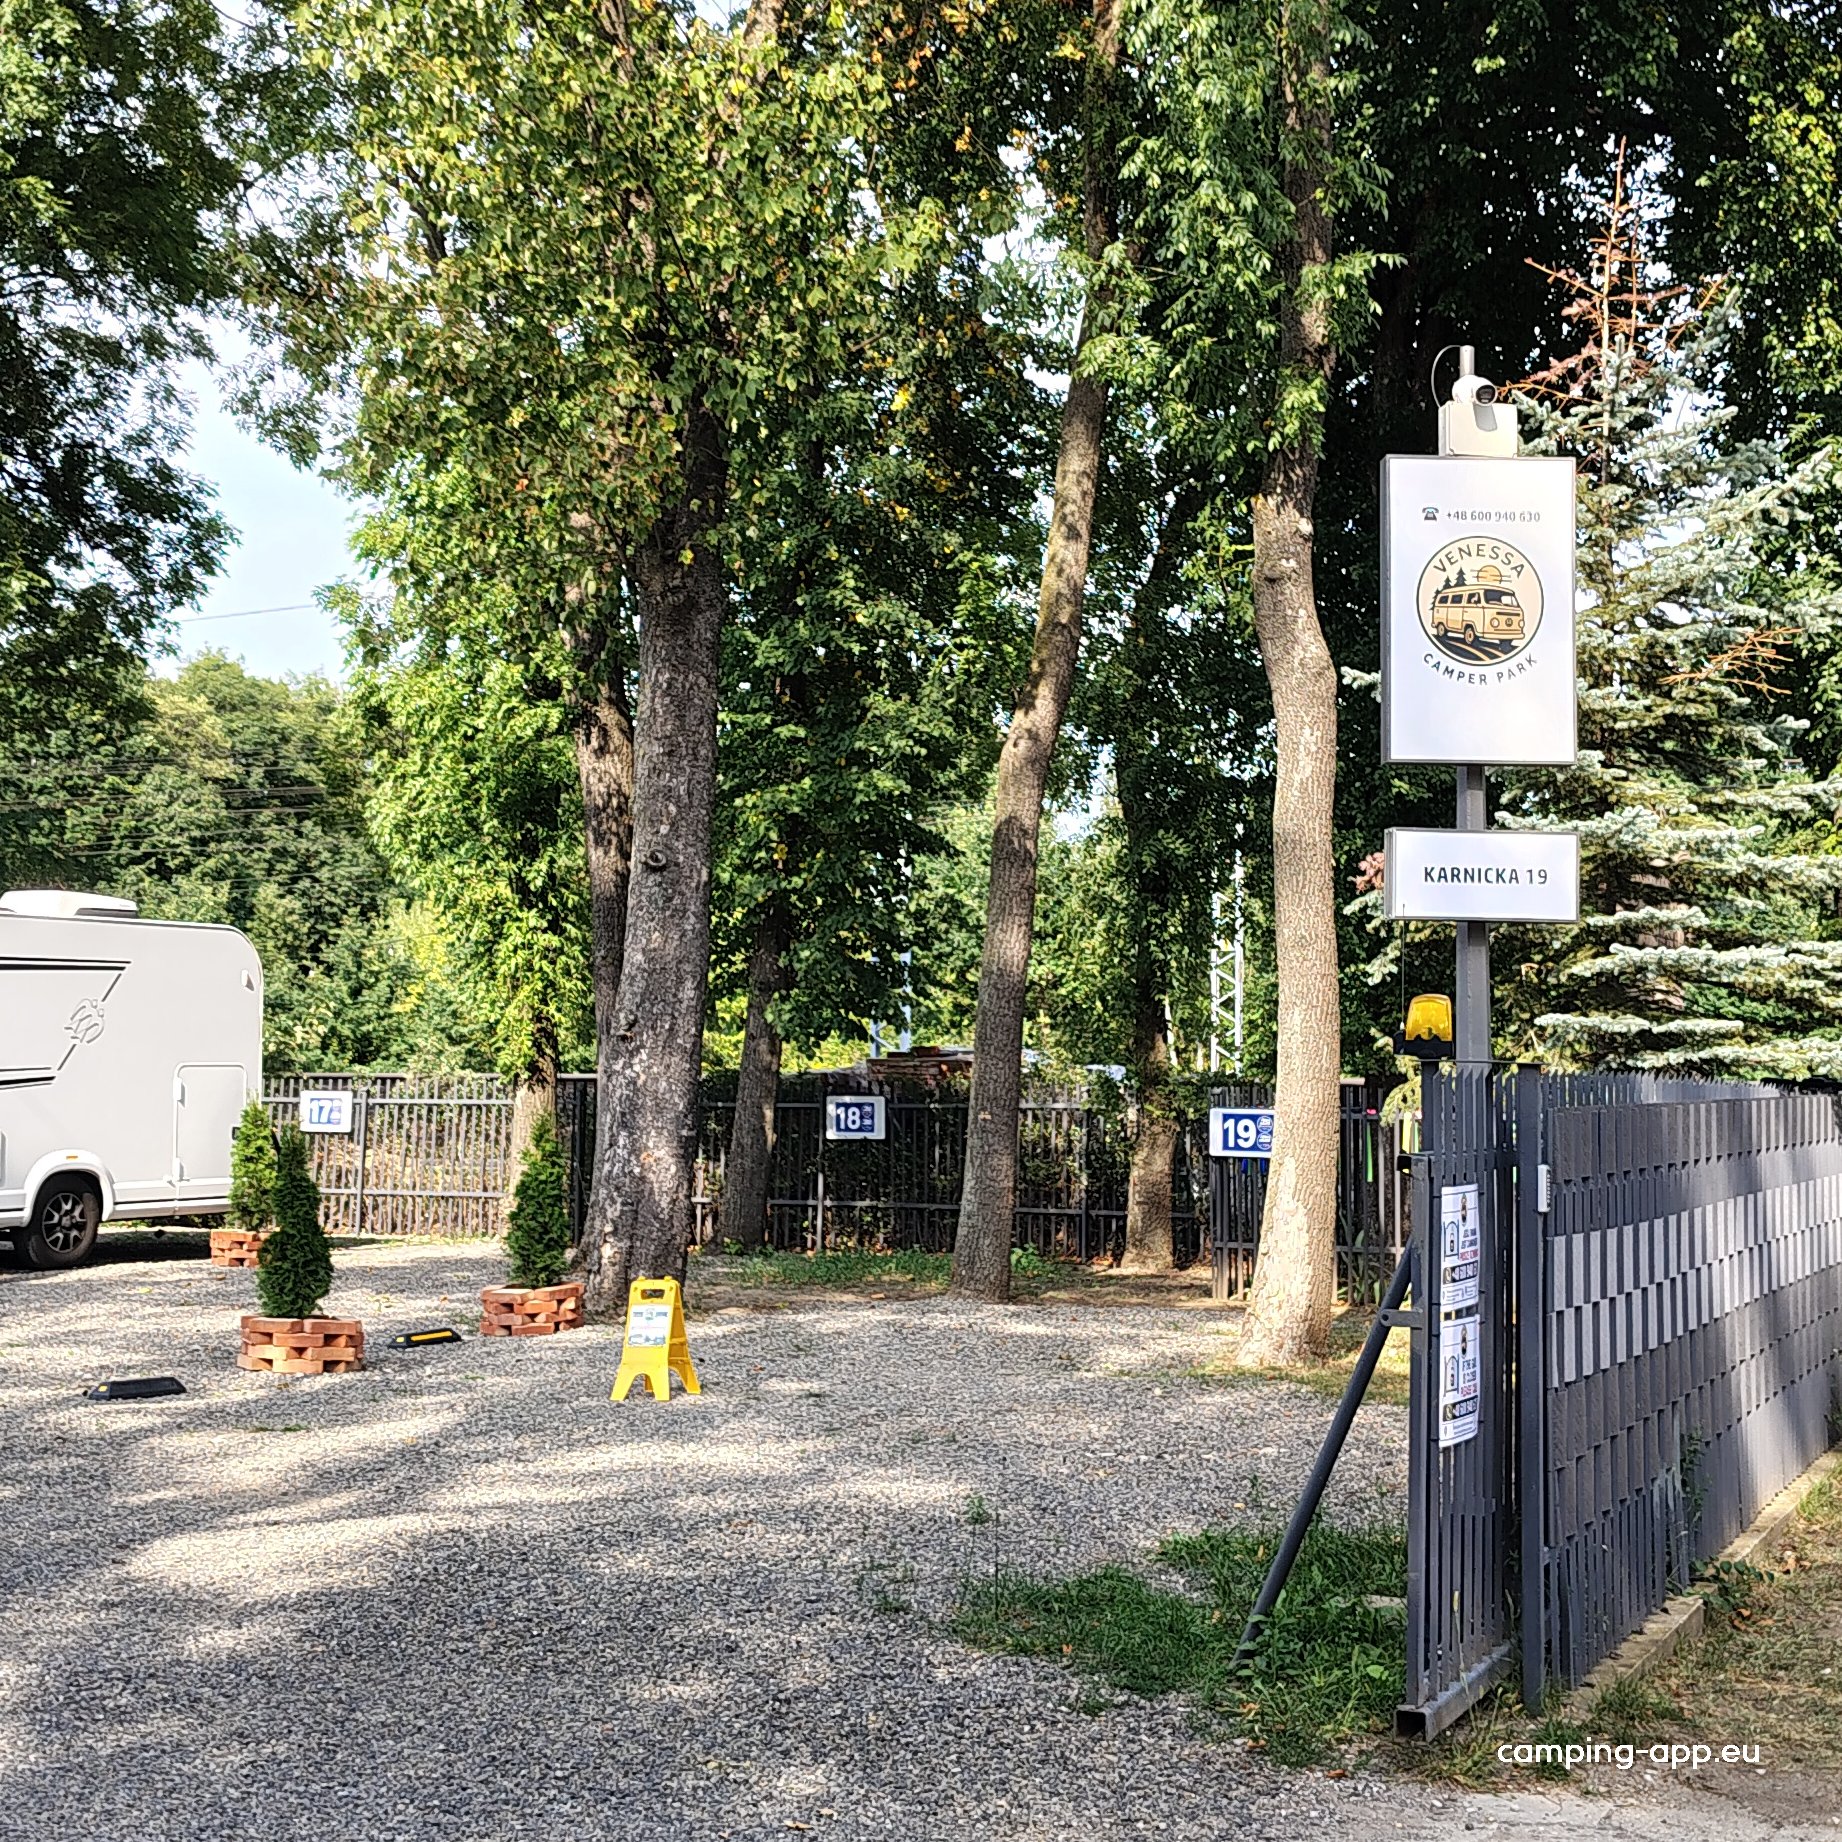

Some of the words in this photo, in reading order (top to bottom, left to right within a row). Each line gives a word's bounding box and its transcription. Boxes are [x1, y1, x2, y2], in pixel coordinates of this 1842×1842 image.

[1446, 510, 1467, 521] +48
[1470, 511, 1492, 522] 600
[1433, 543, 1525, 579] VENESSA
[1423, 653, 1488, 686] CAMPER
[1496, 653, 1537, 684] PARK
[1424, 866, 1520, 884] KARNICKA
[1526, 868, 1548, 885] 19
[310, 1099, 333, 1123] 17
[836, 1106, 860, 1130] 18
[1223, 1118, 1257, 1148] 19
